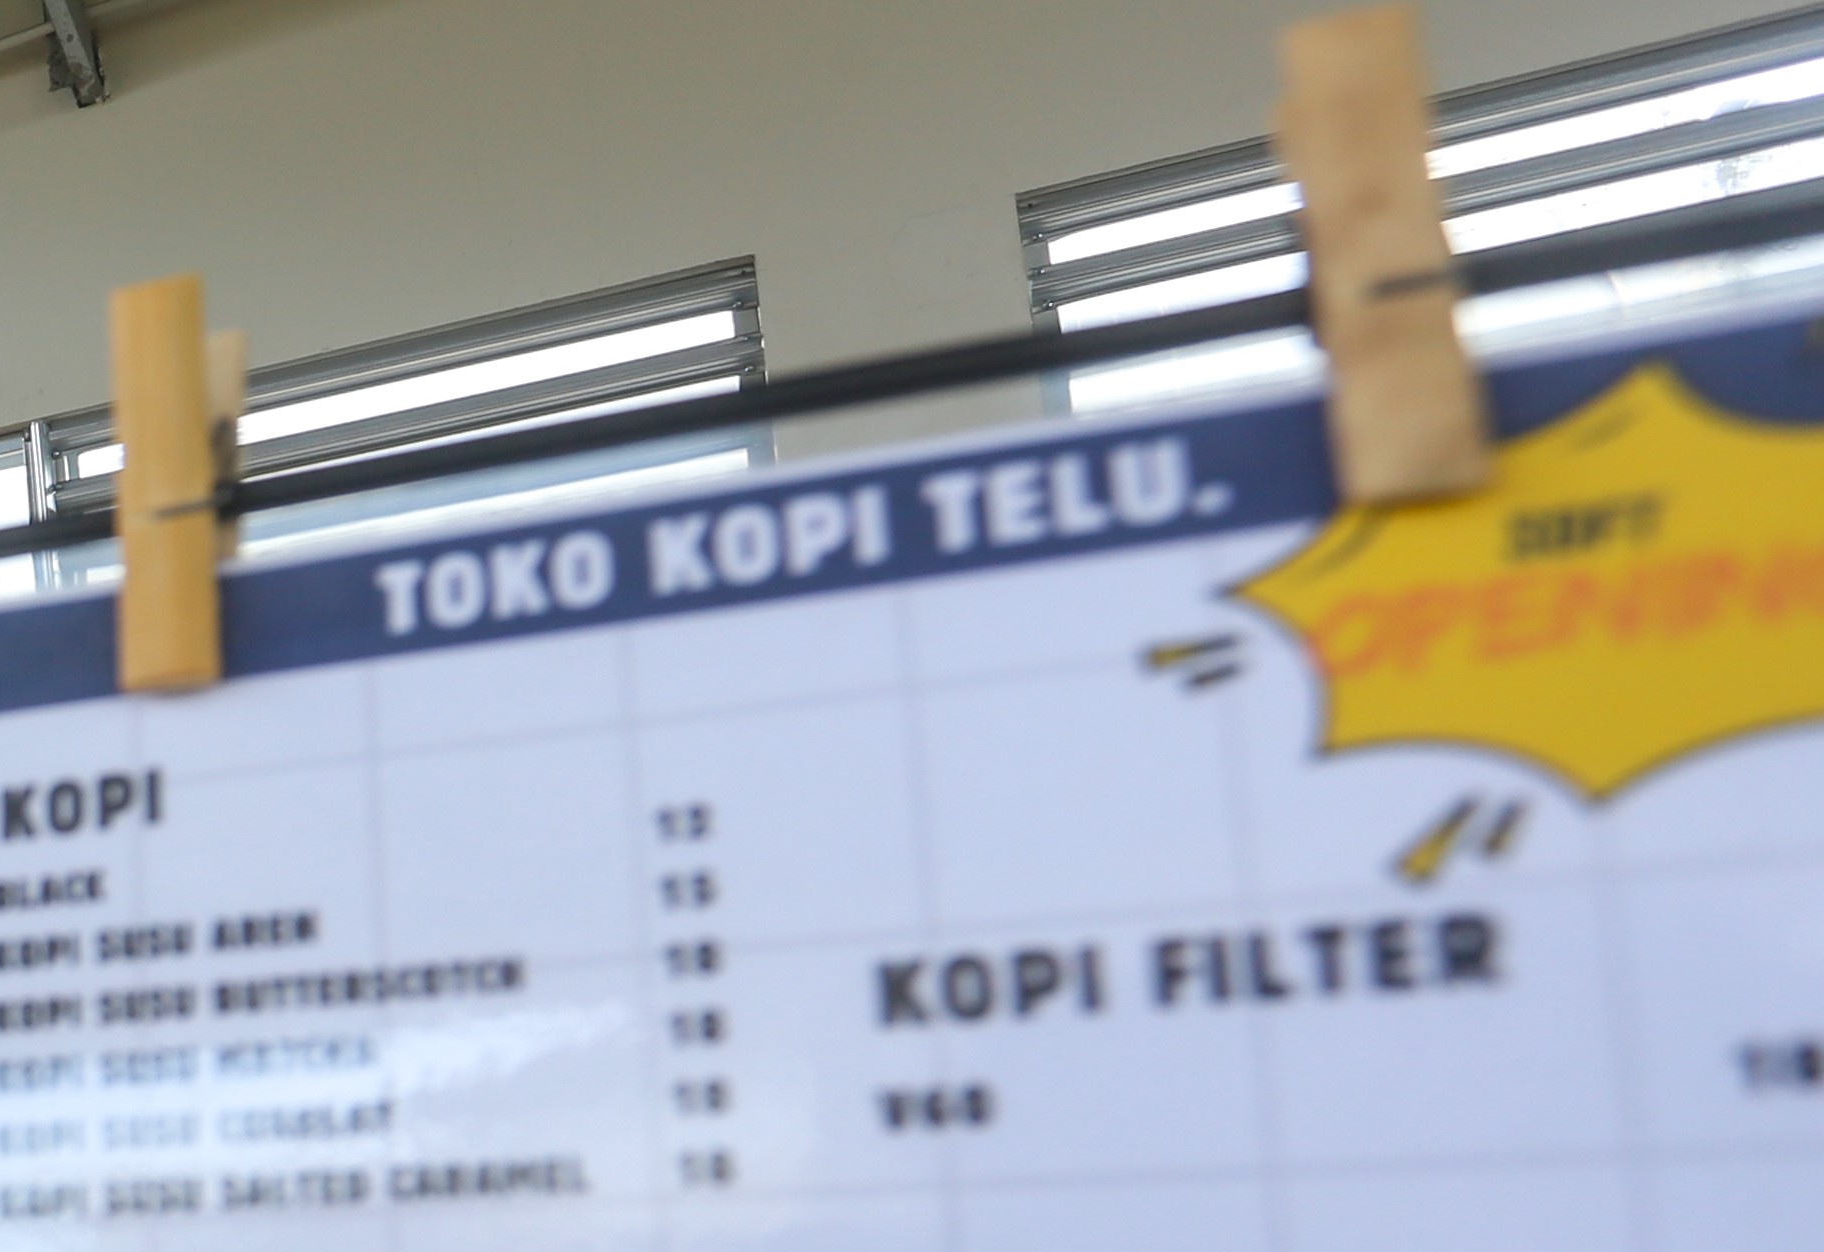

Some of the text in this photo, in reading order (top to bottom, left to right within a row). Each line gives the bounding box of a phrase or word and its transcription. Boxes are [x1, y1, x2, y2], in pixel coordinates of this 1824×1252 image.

[376, 440, 1234, 633] TOKO KOPI TELU.
[0, 769, 162, 842] KOPI
[96, 924, 193, 963] SUSU
[211, 912, 316, 951] AREN
[876, 911, 1501, 1027] KOPI FILTER
[97, 986, 196, 1025] SUSU
[211, 957, 524, 1016] BUTTERSCOTCH
[97, 1043, 199, 1085] SUSU
[102, 1179, 203, 1221] SUSU
[217, 1165, 373, 1209] SALTED
[385, 1159, 591, 1202] CARAMEL
